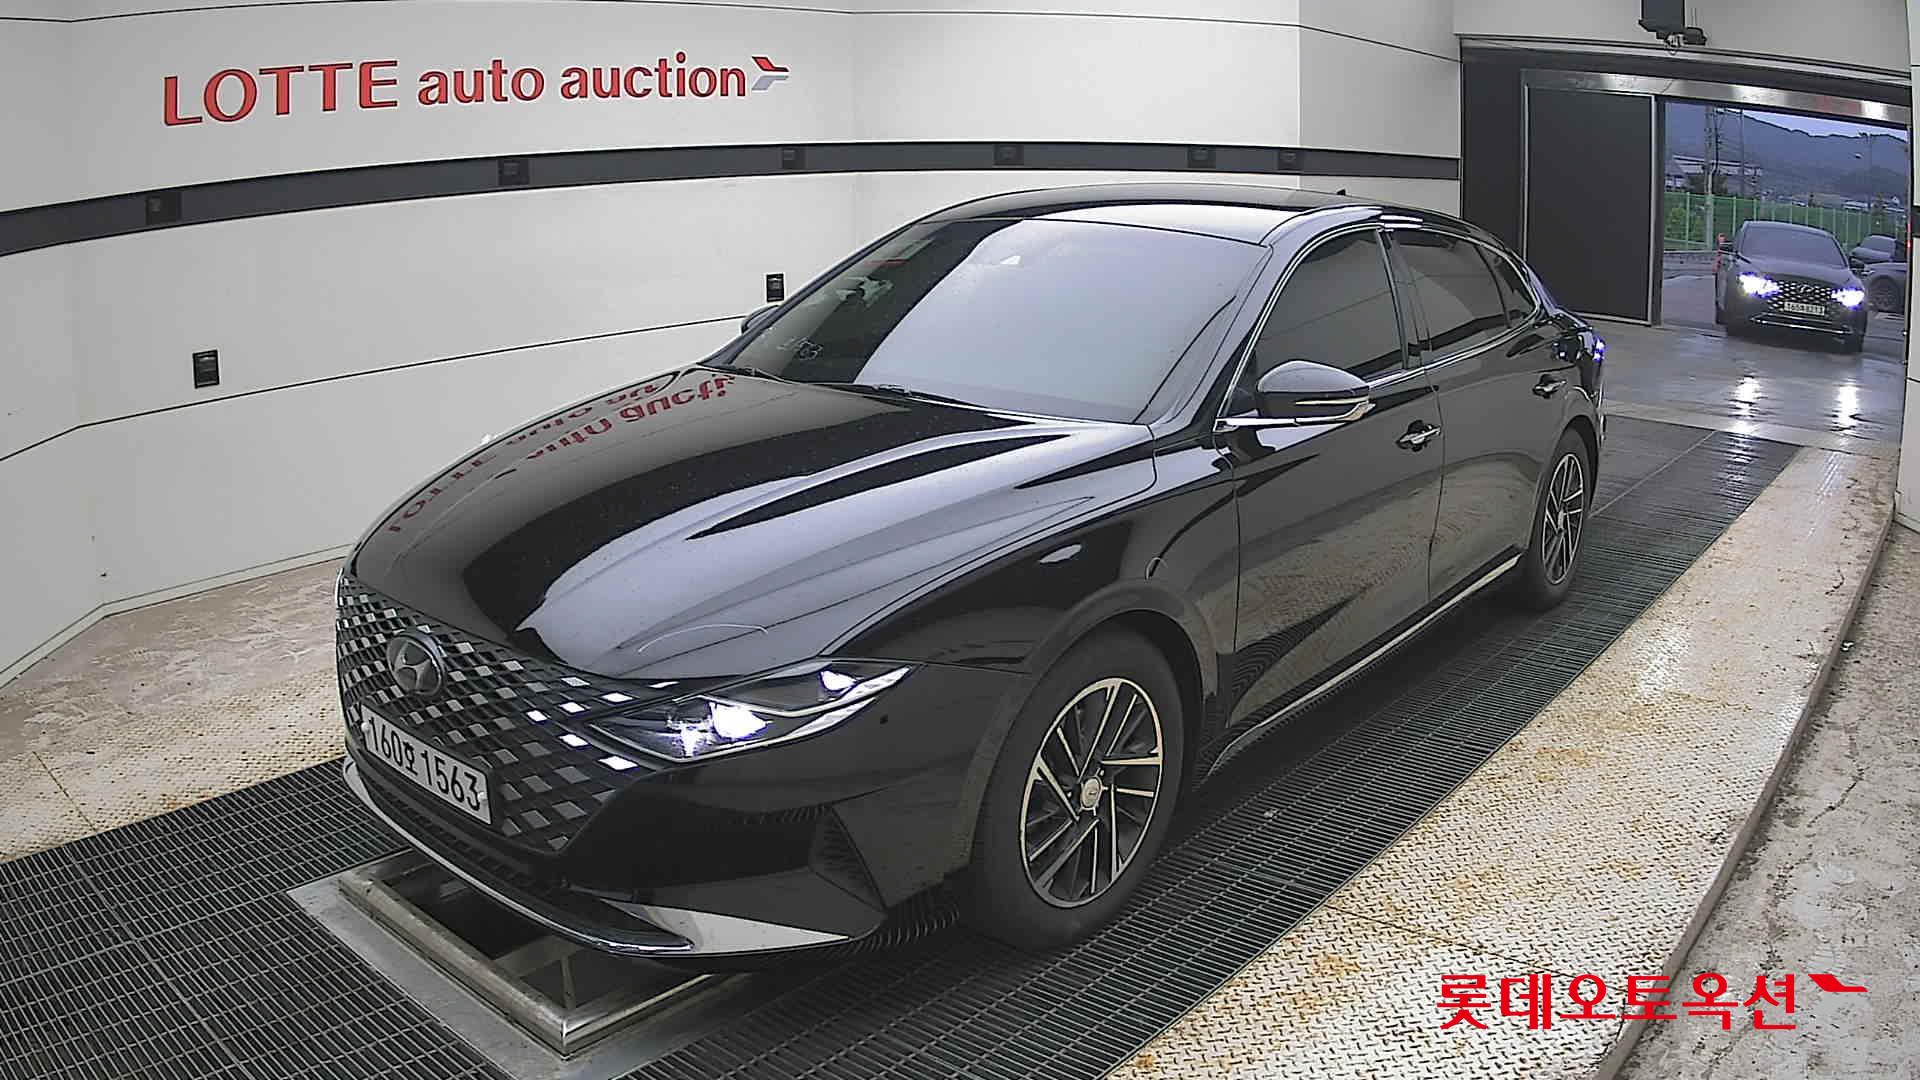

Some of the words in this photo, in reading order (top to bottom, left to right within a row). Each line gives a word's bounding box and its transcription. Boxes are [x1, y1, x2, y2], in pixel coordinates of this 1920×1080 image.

[163, 60, 398, 126] LOTTE
[417, 58, 546, 106] auto
[560, 51, 747, 99] auction
[420, 749, 481, 812] 1563
